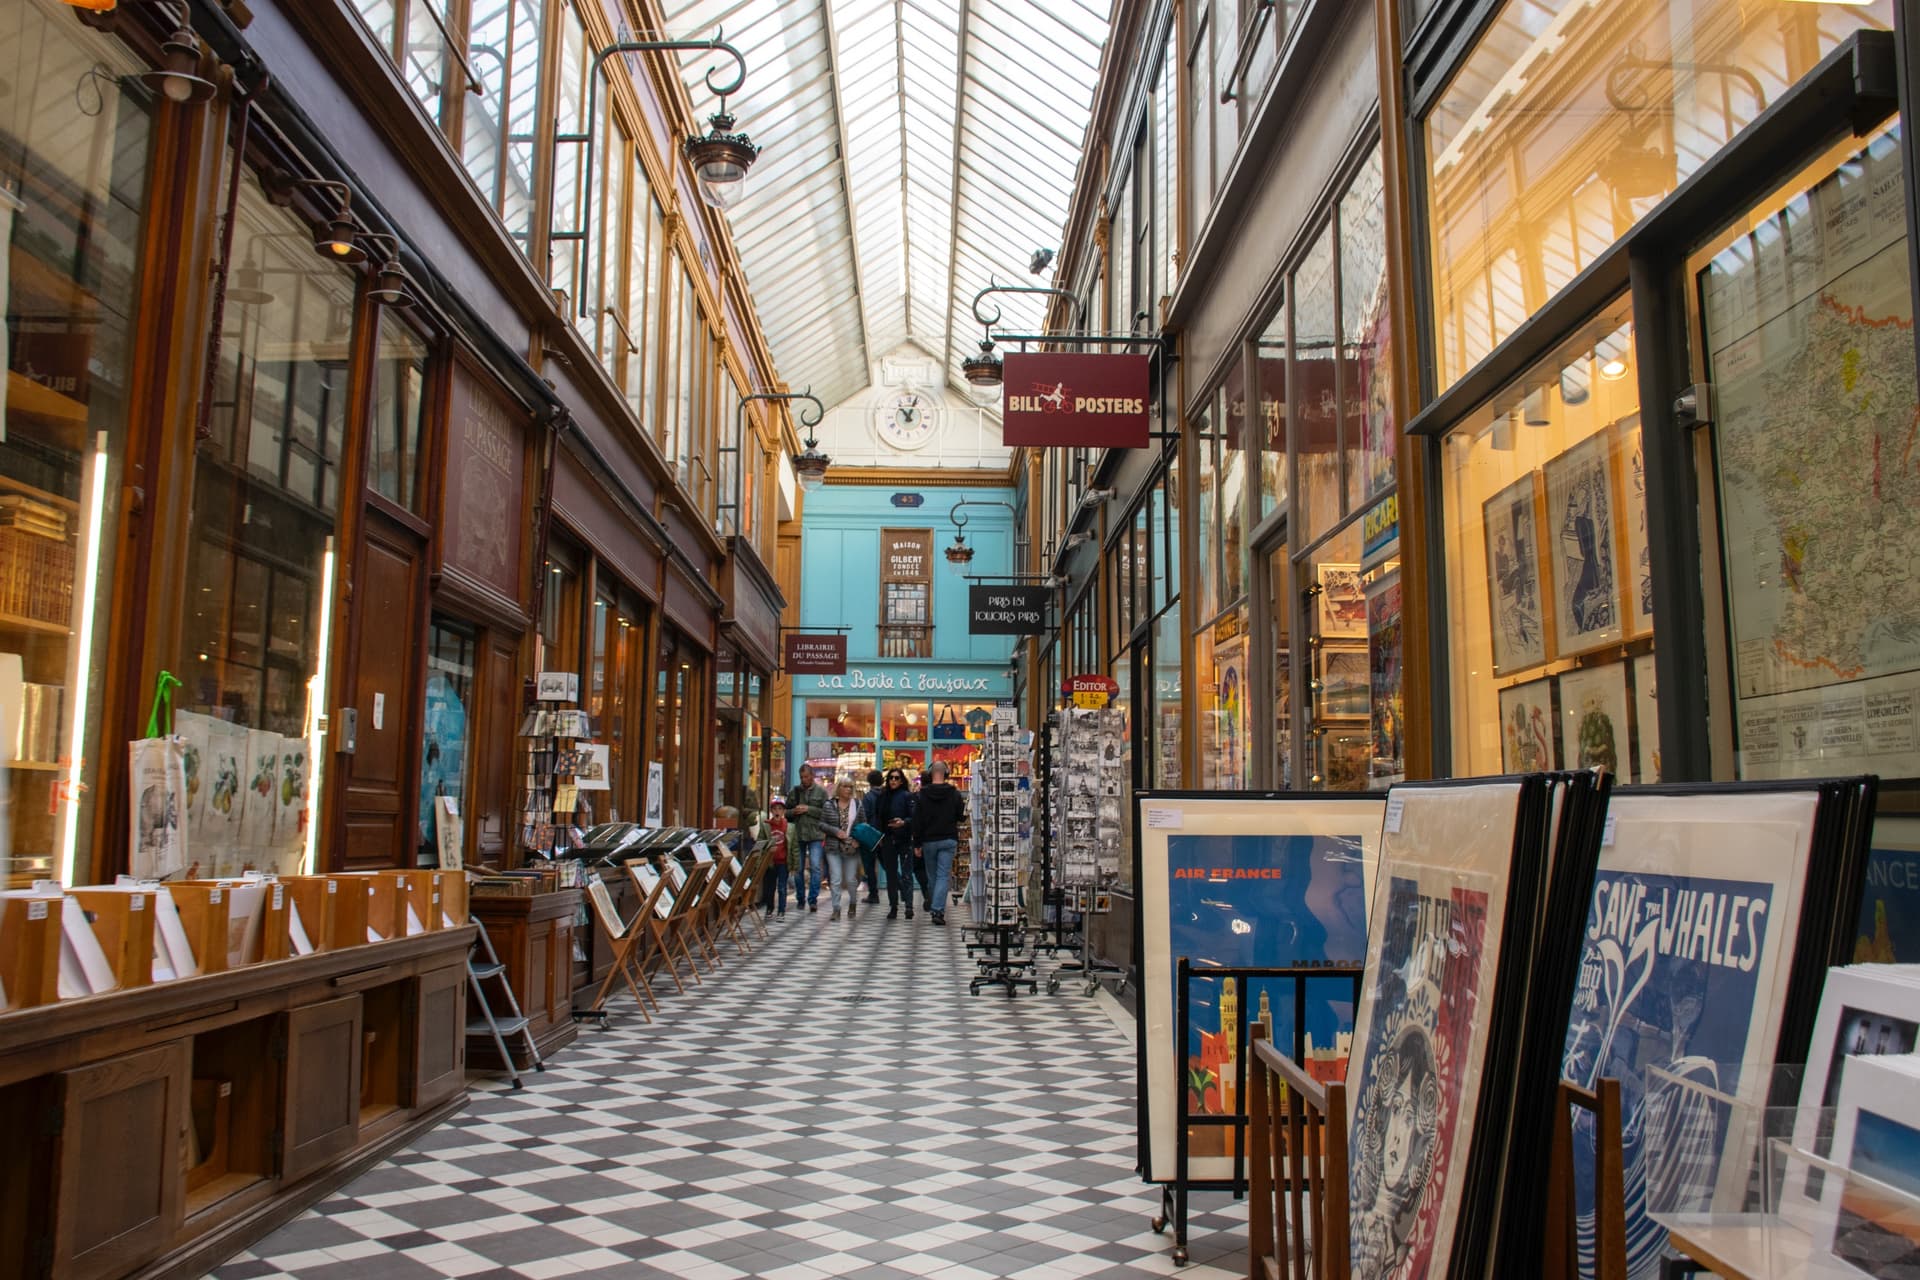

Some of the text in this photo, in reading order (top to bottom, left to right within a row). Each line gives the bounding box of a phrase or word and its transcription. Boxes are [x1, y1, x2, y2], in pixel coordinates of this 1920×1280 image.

[1008, 395, 1143, 414] BILL POSTERS
[476, 421, 513, 475] PASSAGE
[892, 541, 921, 551] MAISON
[890, 555, 923, 564] GILBERT
[1018, 611, 1040, 623] PARIS
[796, 643, 836, 651] LIBRAIRIE
[806, 652, 840, 660] PASSAGE
[900, 671, 914, 689] à
[918, 672, 991, 693] Joujoux
[1073, 680, 1107, 691] EDITOR
[1174, 867, 1282, 879] AIR FRANCE
[1588, 880, 1768, 972] SAVE THE WHALES
